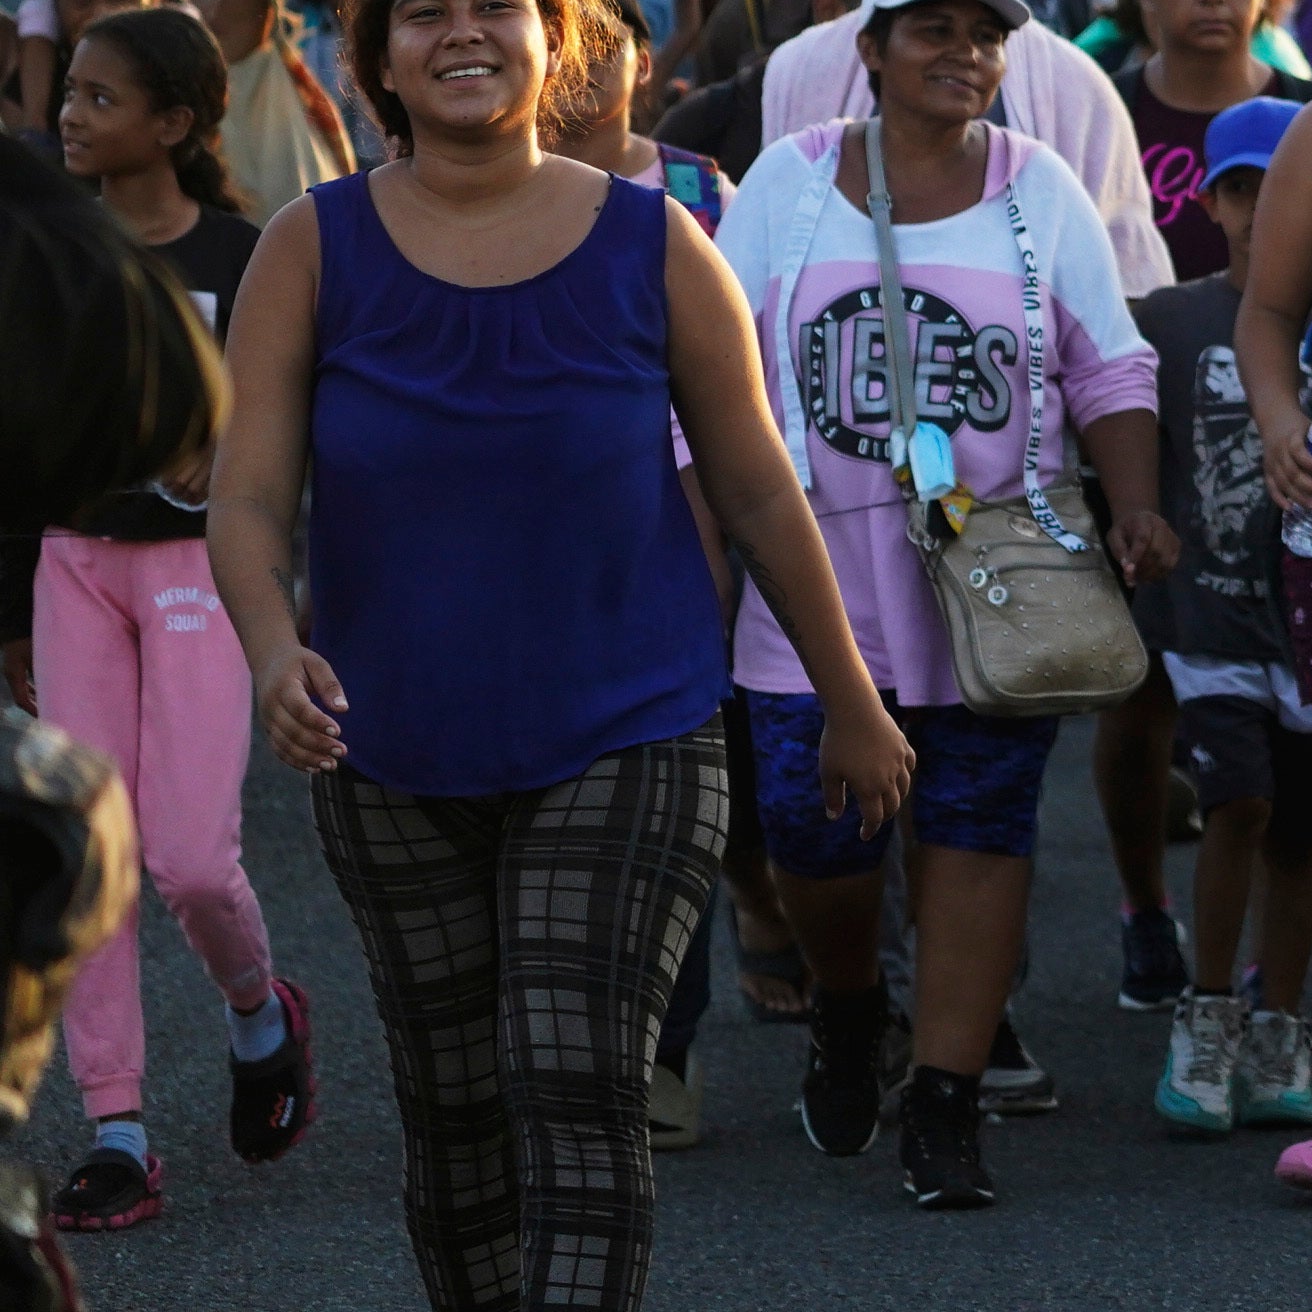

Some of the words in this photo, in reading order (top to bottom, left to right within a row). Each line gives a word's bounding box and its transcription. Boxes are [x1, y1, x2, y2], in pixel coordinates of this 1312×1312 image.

[1028, 326, 1043, 391] VIBES
[1025, 406, 1042, 471] VIBES
[165, 613, 206, 632] SQUAD
